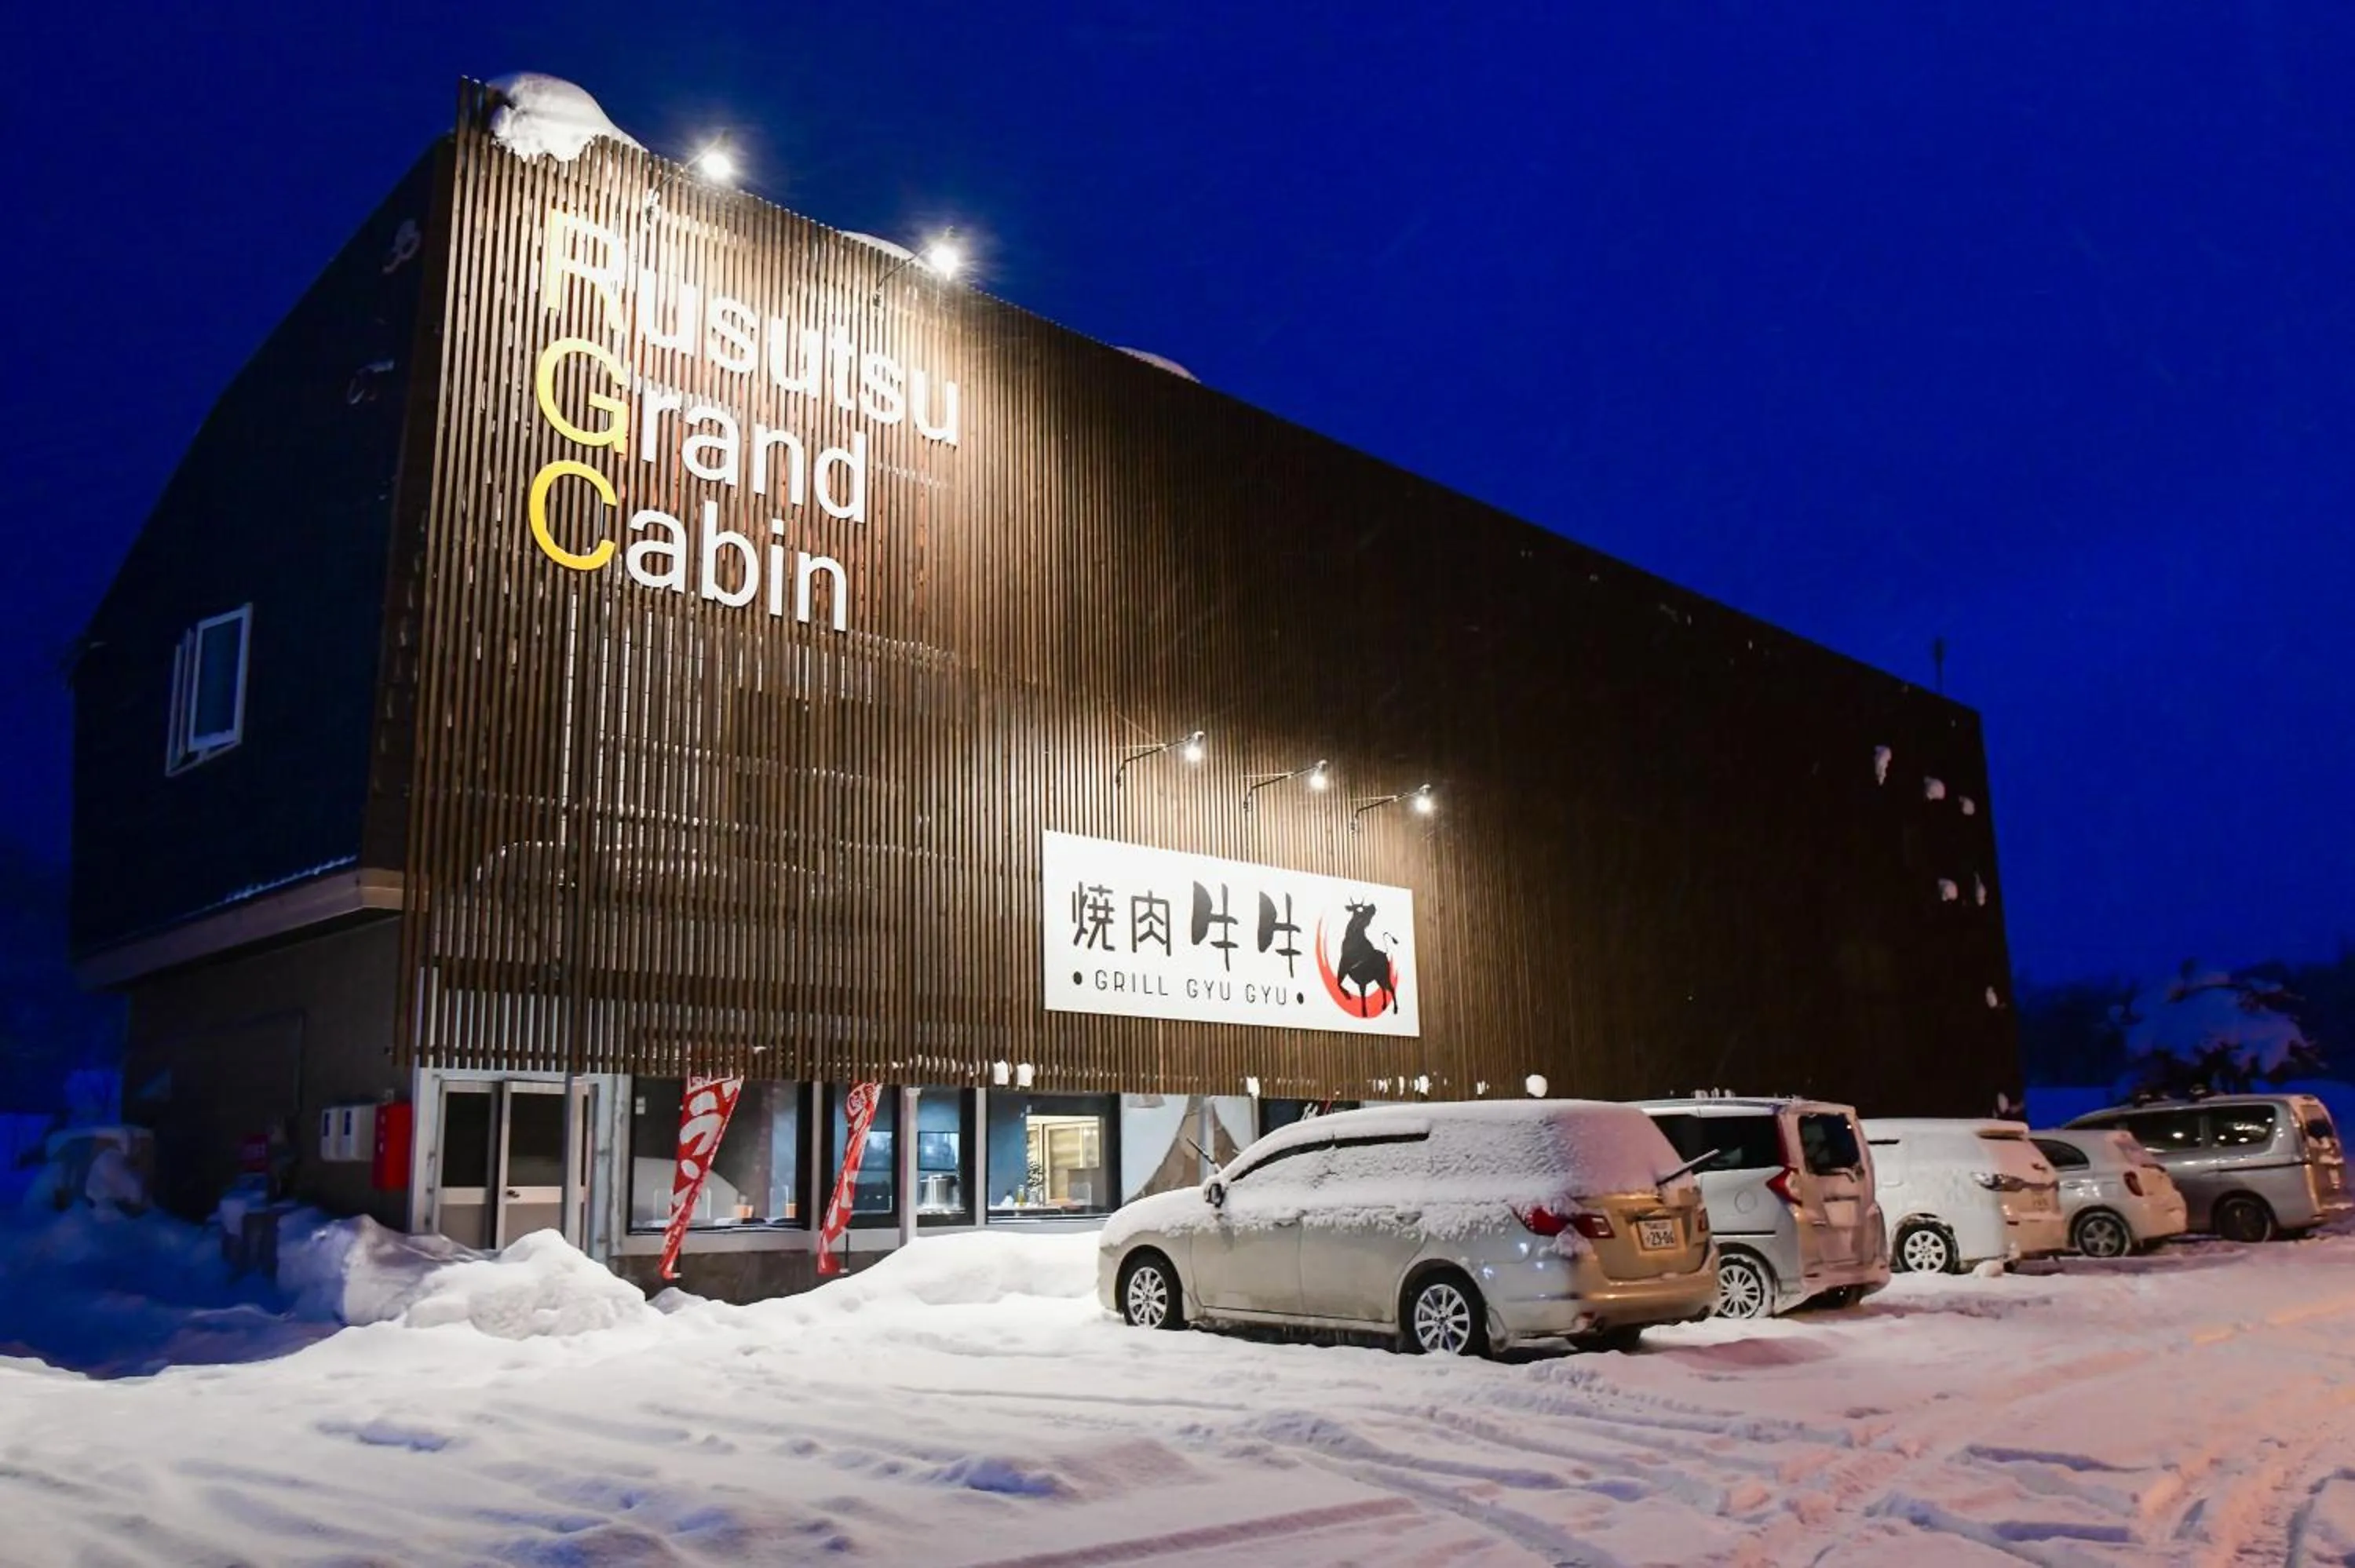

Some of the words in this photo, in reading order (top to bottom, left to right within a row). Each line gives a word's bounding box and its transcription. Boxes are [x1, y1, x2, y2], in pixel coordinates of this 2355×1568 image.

[544, 208, 958, 445] Rusutsu
[536, 337, 865, 523] Grand
[529, 460, 847, 632] Cabin
[1094, 969, 1169, 996] GRILL
[1186, 979, 1231, 1001] GYU
[1245, 984, 1287, 1005] GYU
